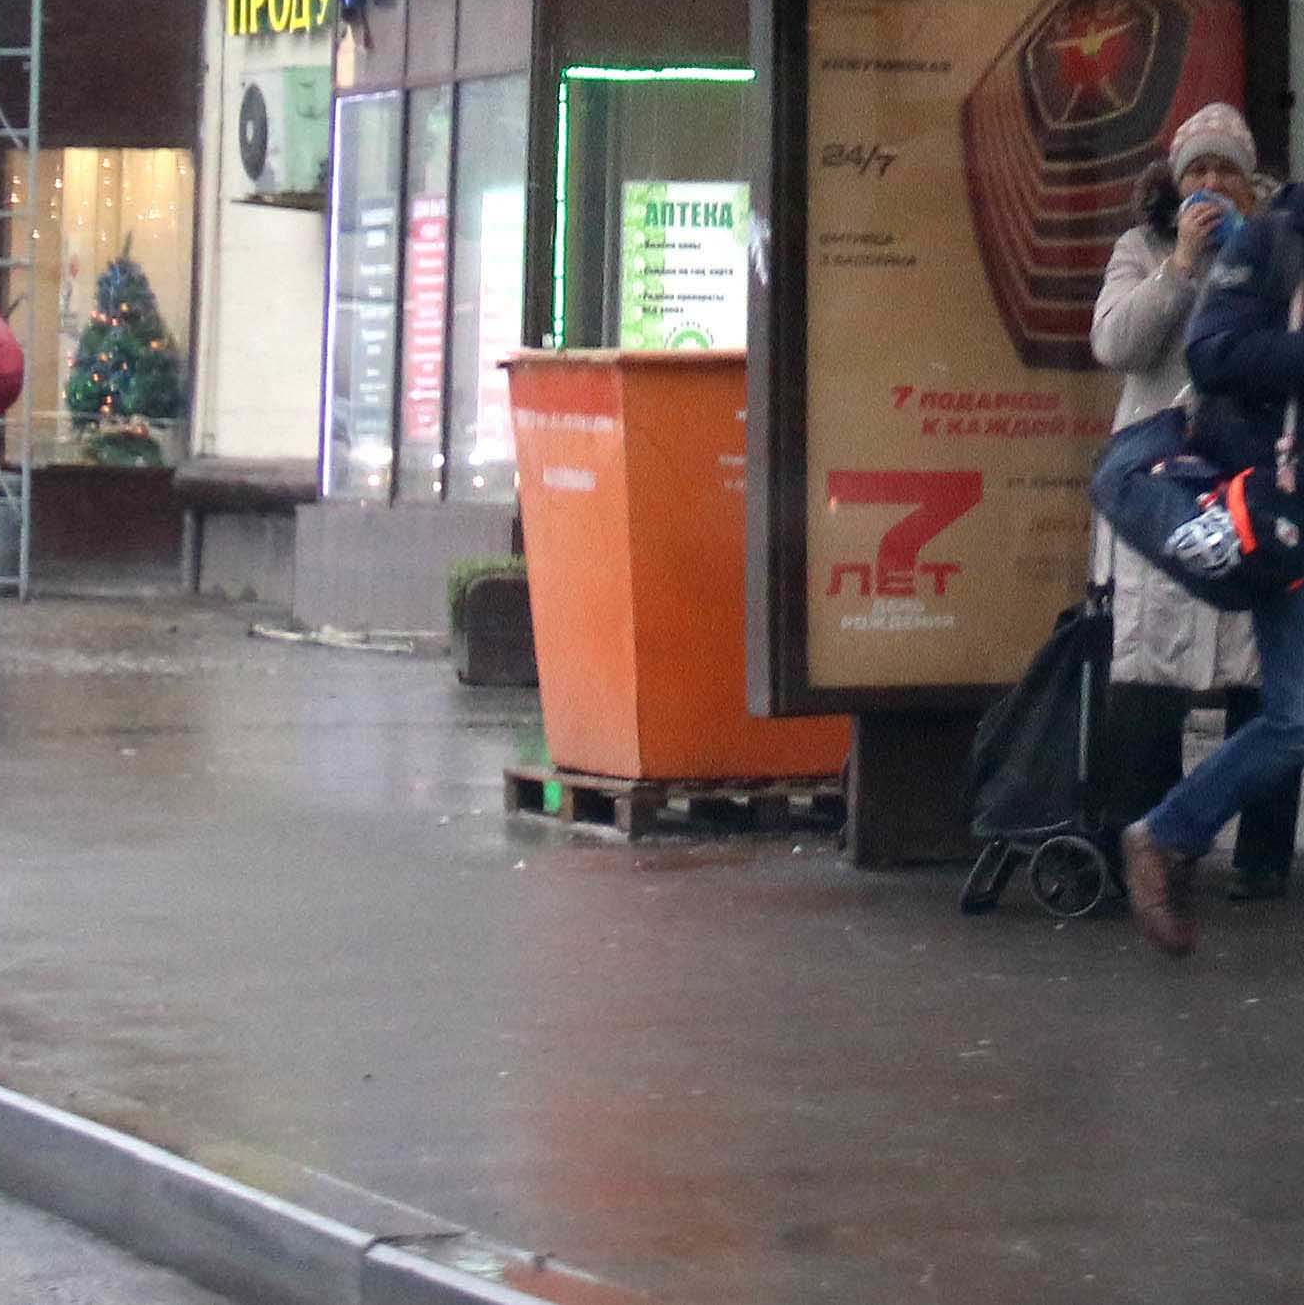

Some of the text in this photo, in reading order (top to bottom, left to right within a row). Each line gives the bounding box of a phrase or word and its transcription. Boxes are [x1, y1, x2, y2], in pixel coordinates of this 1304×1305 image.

[821, 144, 898, 178] 24/7
[644, 201, 734, 230] АПТЕКА
[891, 384, 914, 409] 7
[945, 415, 1066, 438] КАЖДОЙ
[827, 561, 962, 597] ЛЕТ
